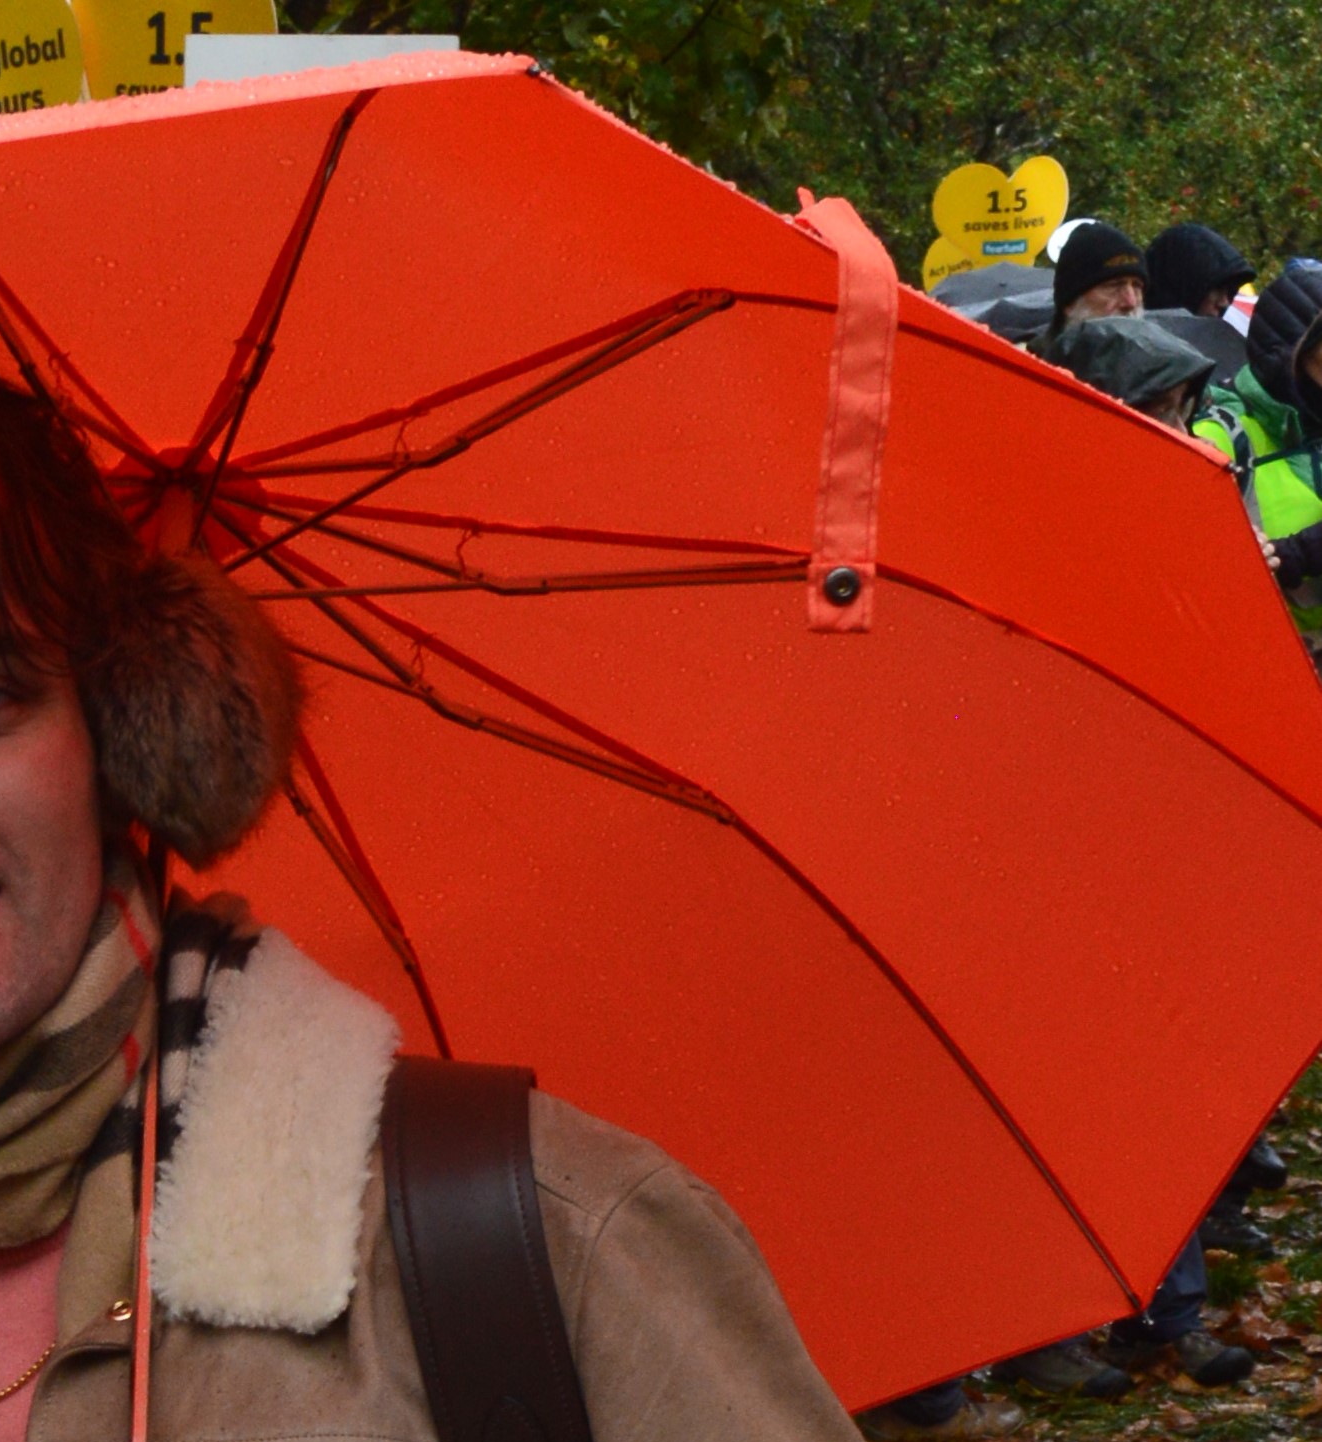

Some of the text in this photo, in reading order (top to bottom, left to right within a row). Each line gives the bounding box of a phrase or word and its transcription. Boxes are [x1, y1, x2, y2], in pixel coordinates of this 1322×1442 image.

[986, 188, 1028, 213] 1.5
[964, 214, 1045, 232] saves lives
